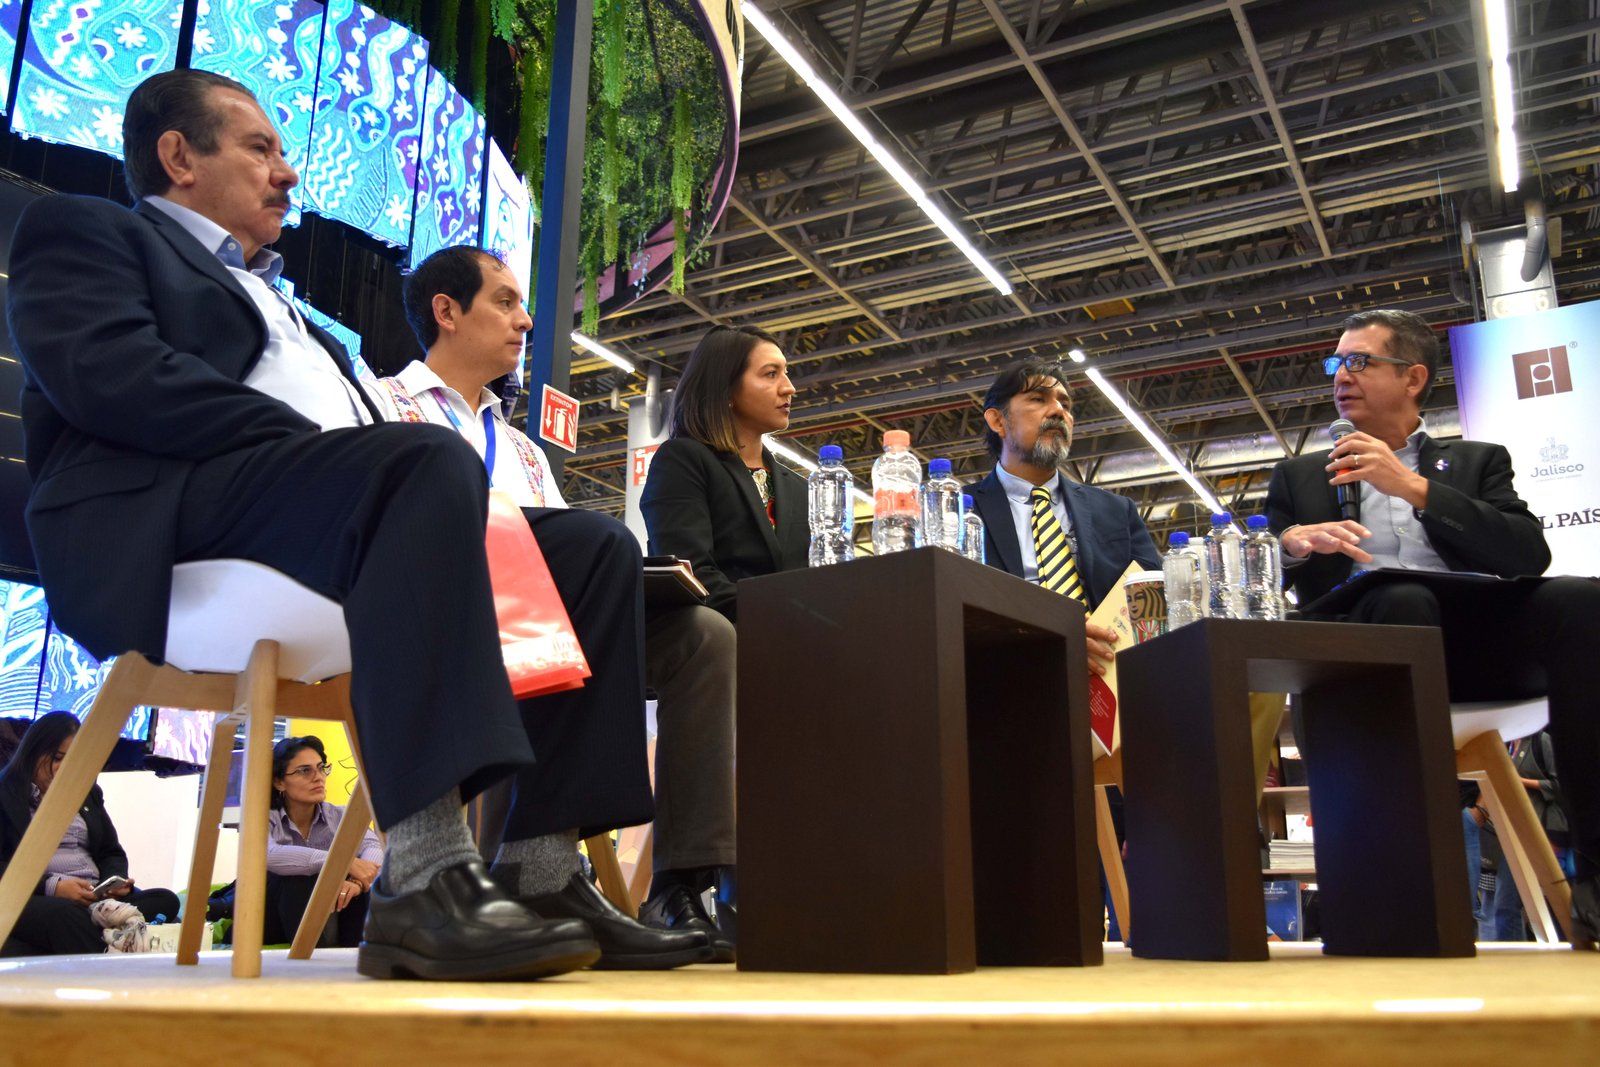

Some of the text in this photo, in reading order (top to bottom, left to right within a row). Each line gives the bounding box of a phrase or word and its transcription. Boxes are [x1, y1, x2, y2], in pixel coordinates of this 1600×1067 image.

[550, 394, 572, 409] EXTINTOR
[1530, 463, 1584, 478] Jalisco
[1537, 508, 1600, 530] L PAÍS
